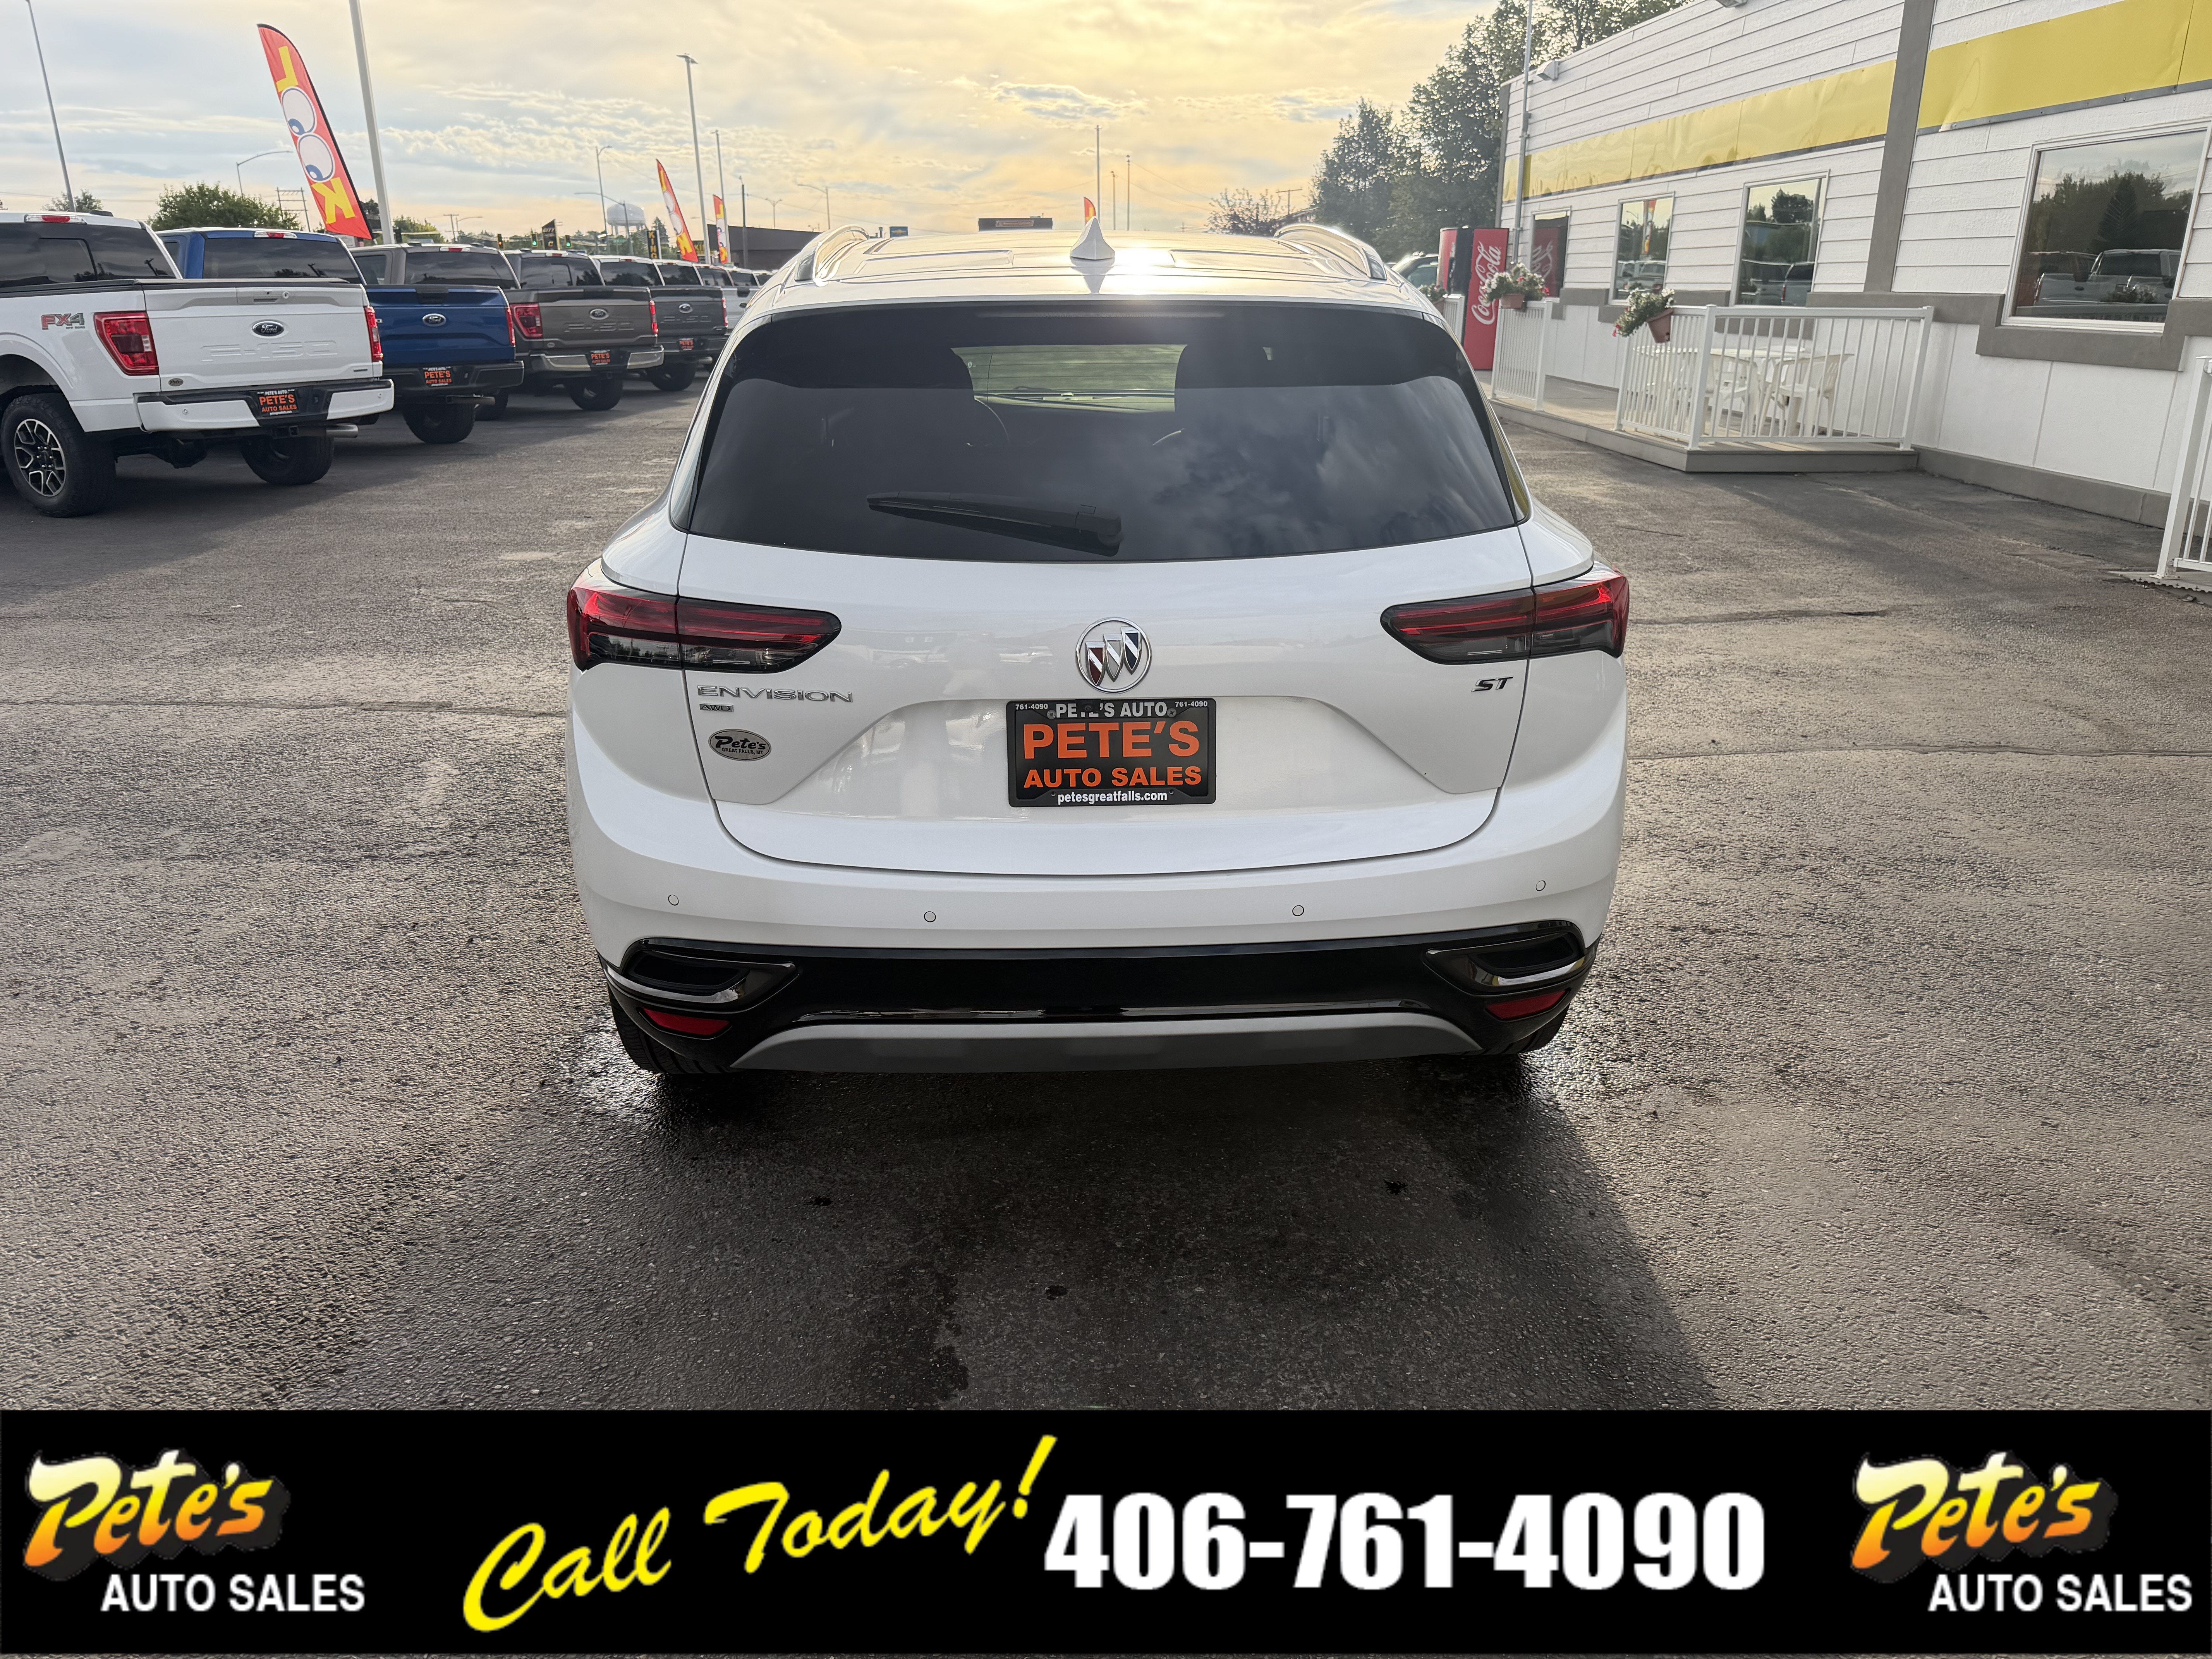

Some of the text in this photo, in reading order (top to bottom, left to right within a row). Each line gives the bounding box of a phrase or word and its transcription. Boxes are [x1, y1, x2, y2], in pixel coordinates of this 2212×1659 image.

[1472, 240, 1502, 325] Coc-Cola
[41, 313, 85, 330] FX4
[261, 324, 278, 333] Ford
[200, 340, 338, 362] F-150
[424, 370, 451, 379] PETE'S
[259, 394, 295, 405] PETE'S
[1471, 676, 1514, 692] ST
[697, 685, 853, 702] ENVISION
[1120, 701, 1169, 717] AUTO
[714, 735, 766, 750] Pete's
[1024, 721, 1200, 759] PETE'S
[1024, 766, 1201, 788] AUTO SALES
[1058, 790, 1167, 805] petesgreatfalls.com
